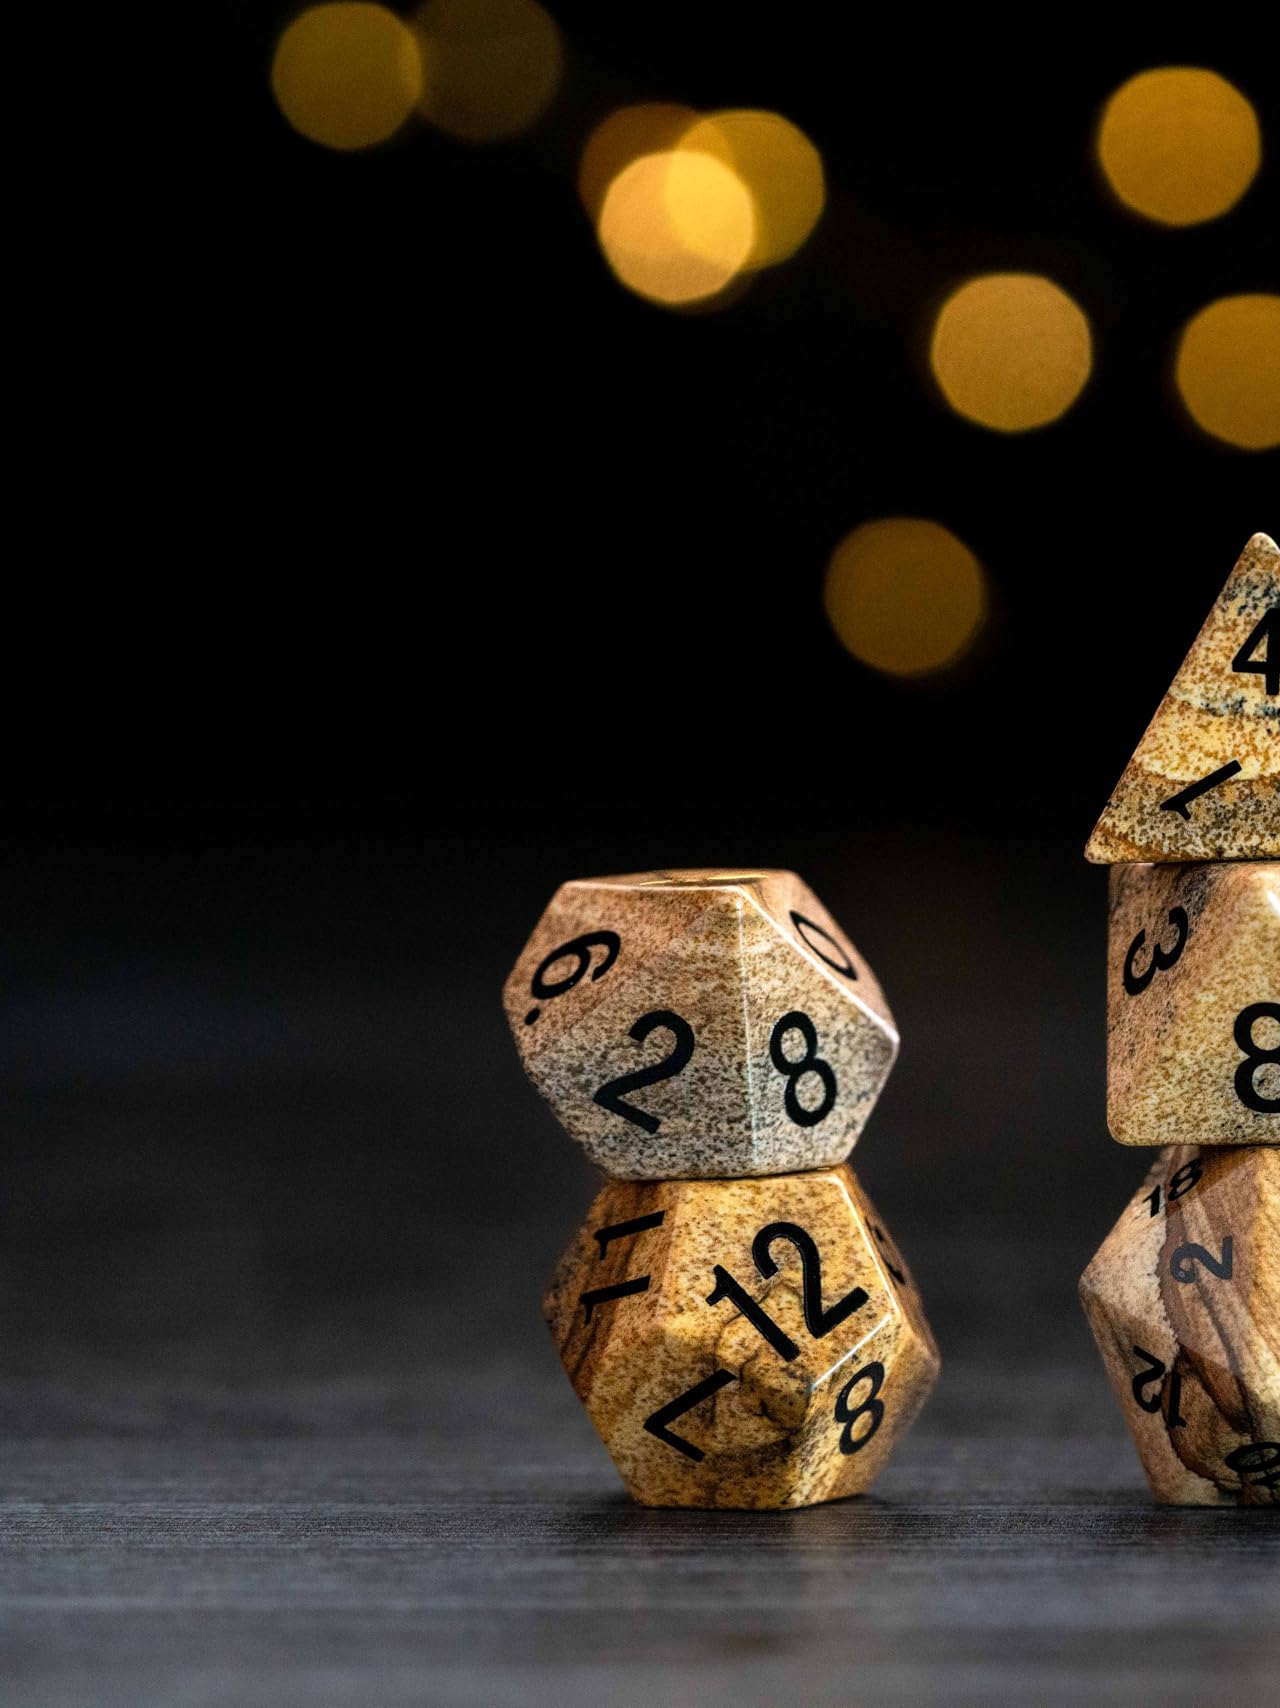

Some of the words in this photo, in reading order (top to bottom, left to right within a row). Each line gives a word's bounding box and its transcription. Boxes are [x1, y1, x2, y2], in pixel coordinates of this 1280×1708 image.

[1159, 759, 1242, 820] 1
[789, 910, 858, 981] 0
[1123, 906, 1189, 996] 3
[593, 1010, 696, 1135] 2
[769, 1010, 837, 1127] 8
[1143, 1158, 1203, 1218] 18
[579, 1210, 665, 1325] 11
[705, 1221, 870, 1362] 12
[1170, 1235, 1233, 1284] 2
[834, 1360, 885, 1455] 8
[1132, 1345, 1187, 1428] 12
